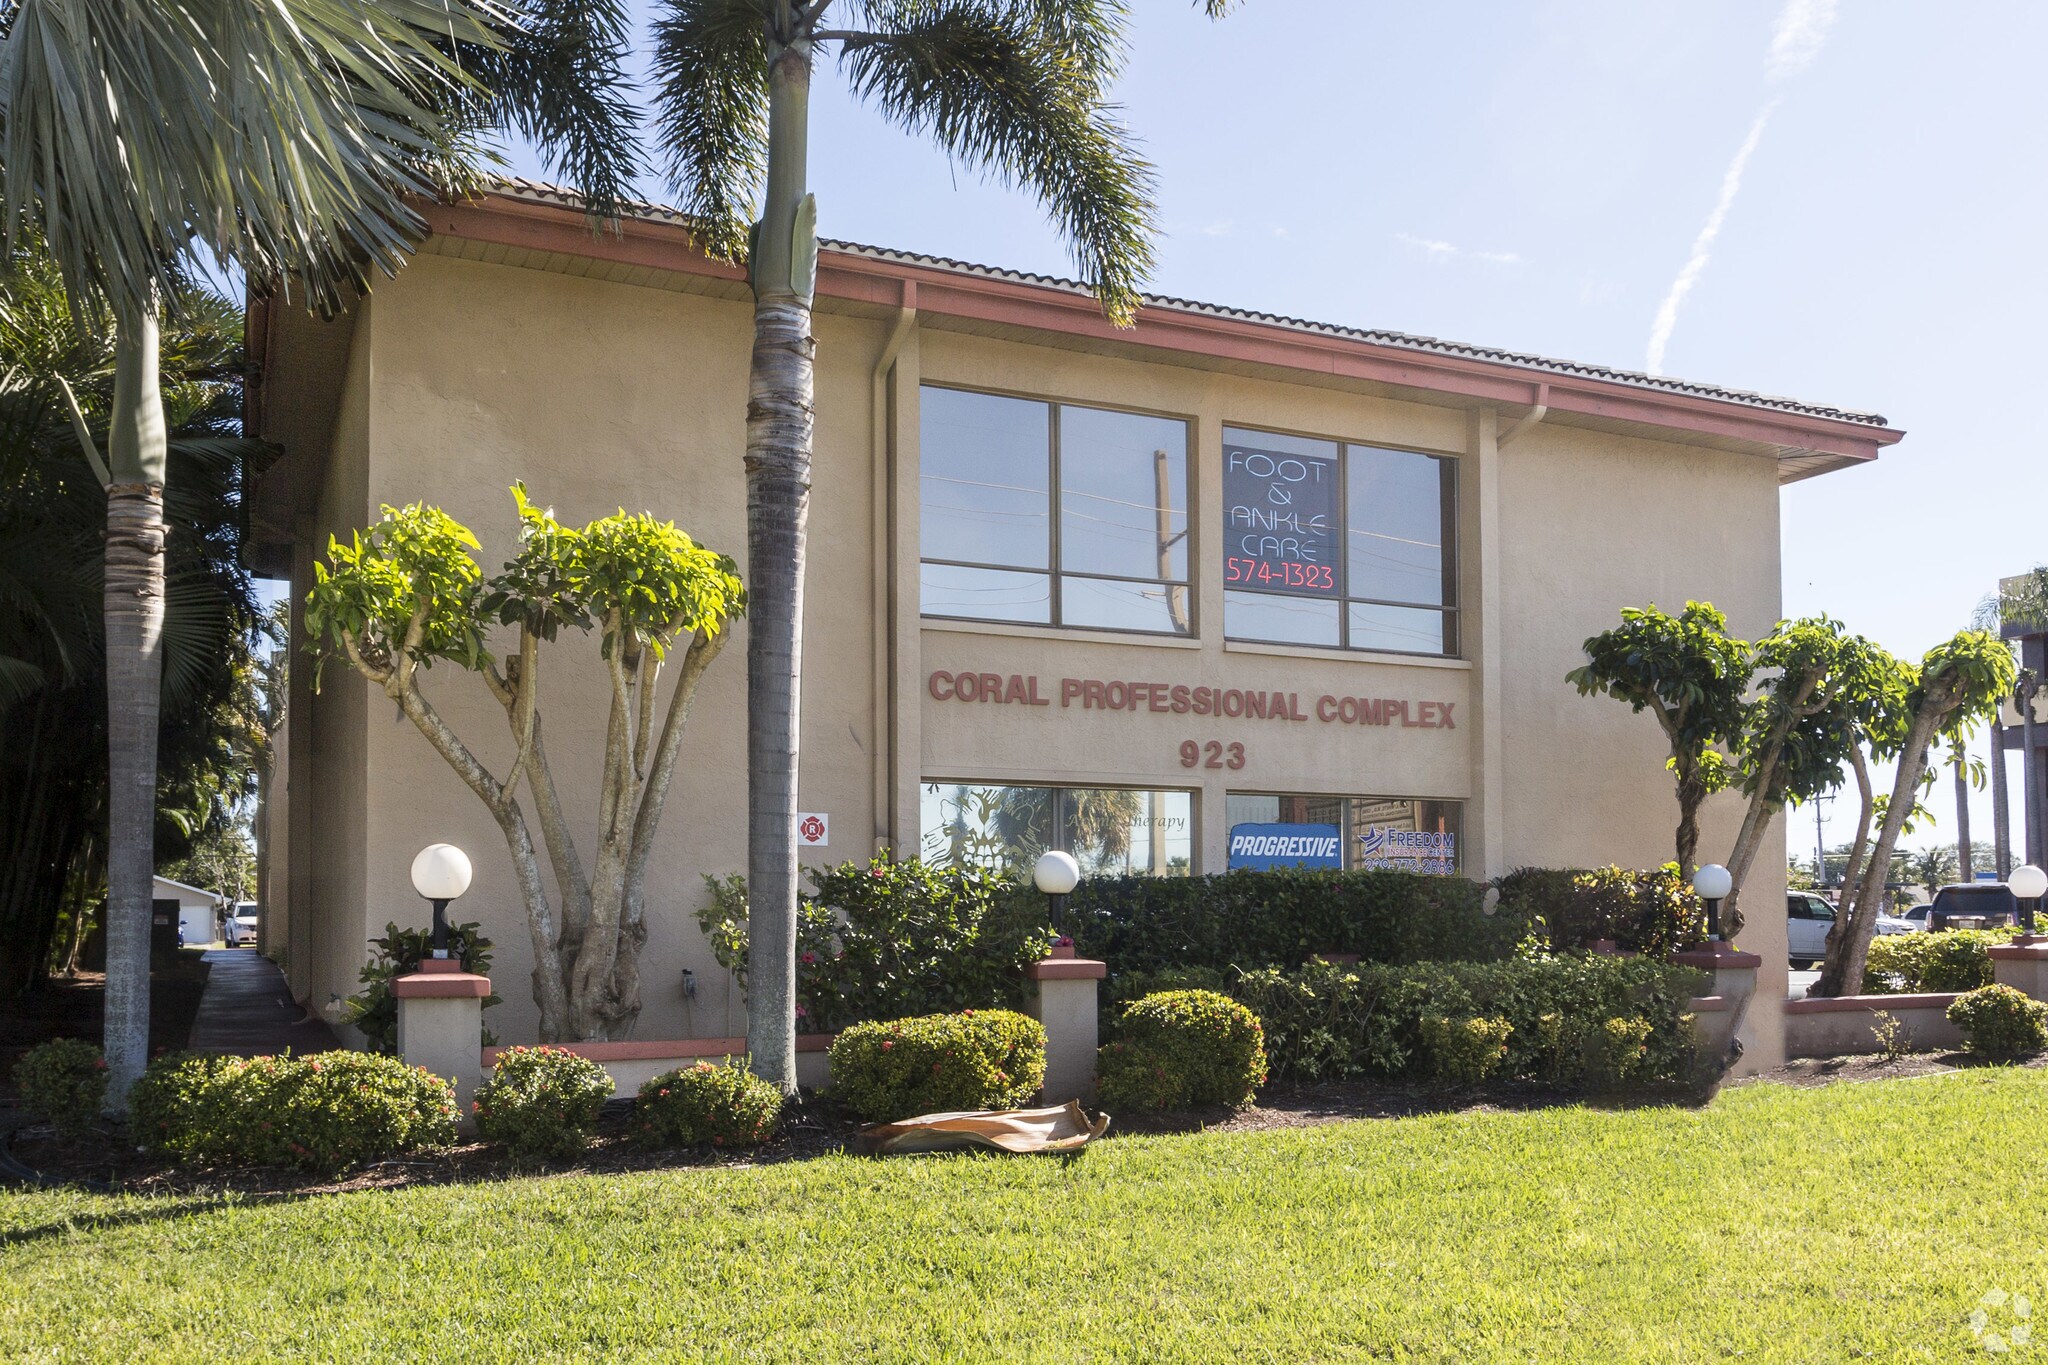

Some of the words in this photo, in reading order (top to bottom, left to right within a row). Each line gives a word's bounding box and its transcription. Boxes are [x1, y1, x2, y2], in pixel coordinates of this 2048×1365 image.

[1229, 451, 1327, 483] FOOT
[1268, 482, 1292, 505] &
[1231, 505, 1327, 537] ANKLE
[1241, 534, 1317, 562] CARE
[1226, 557, 1334, 589] 574-1323
[929, 670, 1050, 706] CORAL
[1061, 678, 1308, 721] PROFESSIONAL
[1316, 694, 1456, 729] COMPLEX
[1180, 739, 1246, 770] 923
[809, 825, 816, 834] R
[1387, 828, 1455, 847] FREEDOM
[1231, 835, 1339, 857] PROGRESSIVE
[1387, 847, 1428, 858] INSURANCE
[1428, 847, 1455, 858] CENTER
